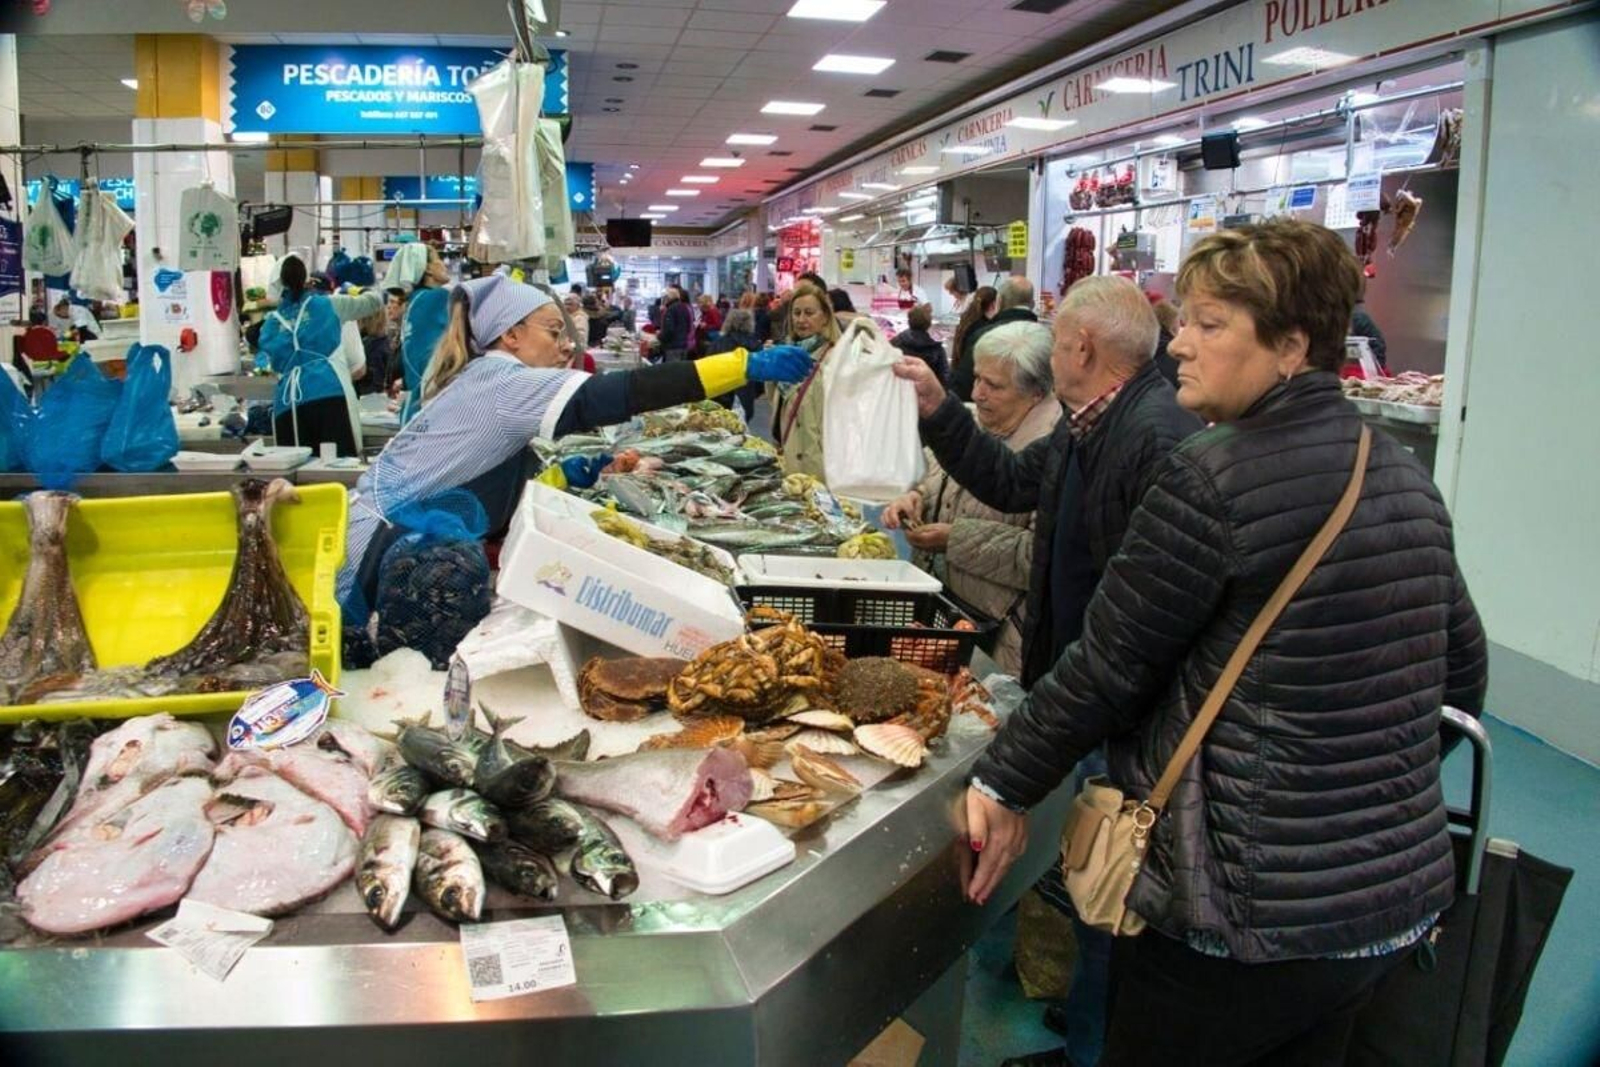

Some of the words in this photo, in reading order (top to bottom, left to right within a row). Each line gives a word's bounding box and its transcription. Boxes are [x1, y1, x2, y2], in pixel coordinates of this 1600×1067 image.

[1265, 0, 1388, 43] POLLE
[283, 58, 441, 86] PESCADERÍA
[1176, 43, 1254, 101] TRINI
[325, 90, 393, 102] PESCADOS
[394, 91, 405, 102] Y
[406, 91, 473, 103] MARISCOS
[575, 575, 674, 639] Distribumar
[508, 979, 537, 993] 14.00
